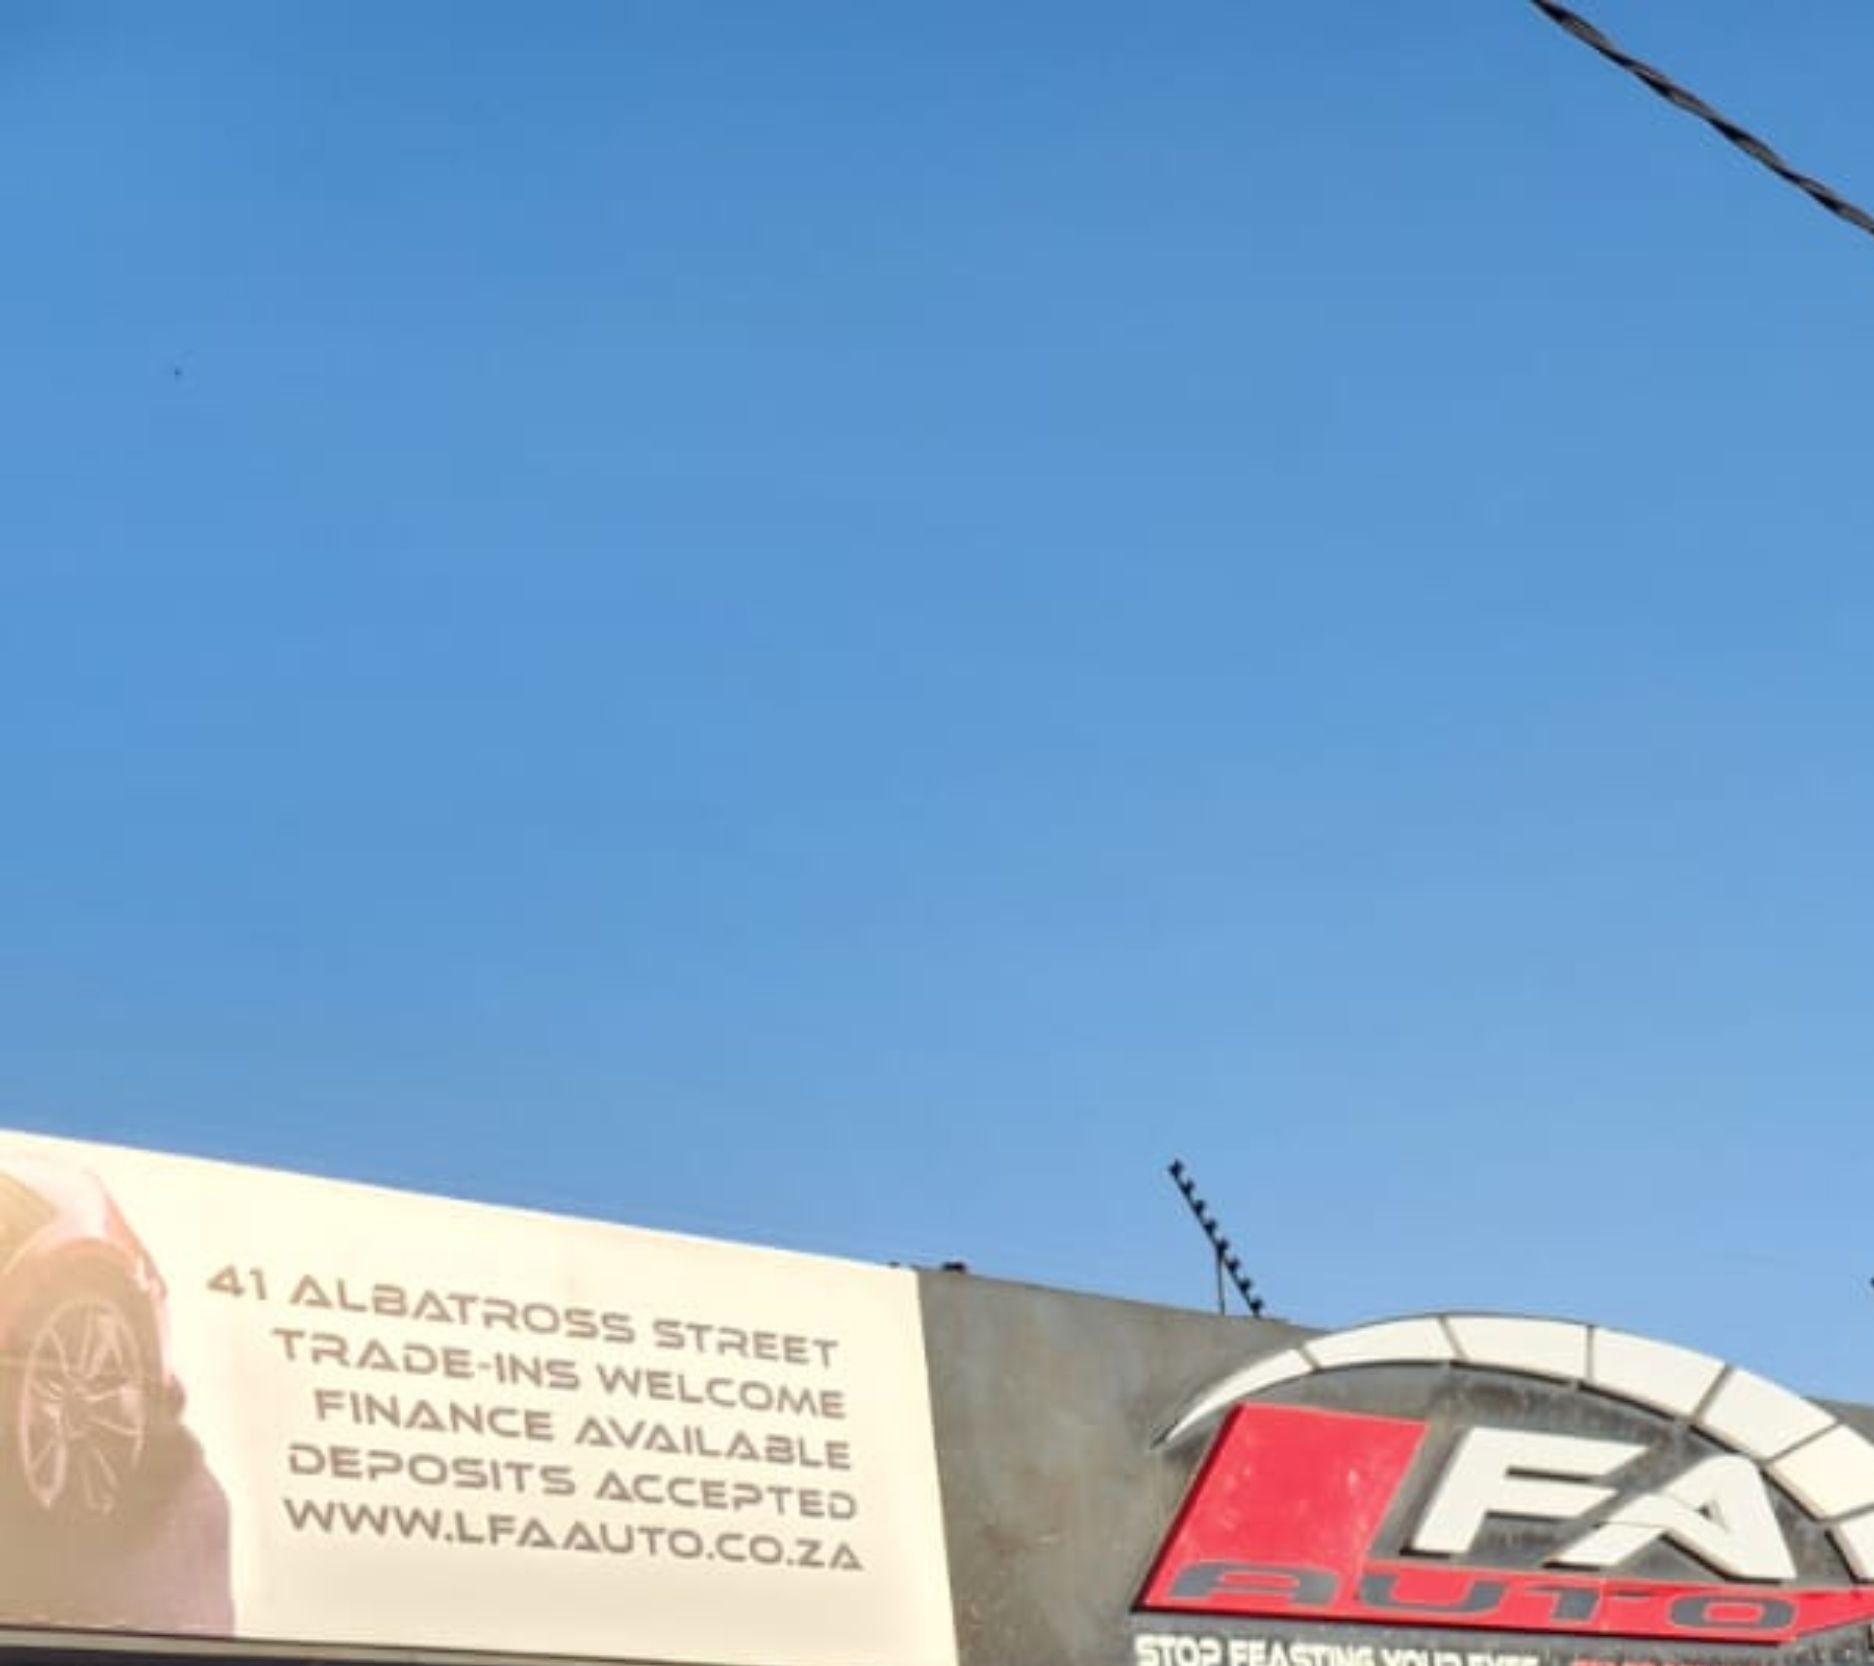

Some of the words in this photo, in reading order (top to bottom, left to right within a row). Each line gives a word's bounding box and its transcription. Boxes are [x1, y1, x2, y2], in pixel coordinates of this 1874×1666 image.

[207, 1264, 267, 1301] 41
[289, 1274, 636, 1344] ALBATROSS
[651, 1318, 839, 1369] STREET
[270, 1327, 581, 1391] TRADE-INS
[595, 1362, 847, 1420] WELCOME
[314, 1388, 556, 1442] FINANCE
[575, 1415, 851, 1471] AVAILABLE
[288, 1442, 577, 1497] DEPOSITS
[594, 1470, 858, 1520] ACCEPTED
[282, 1496, 864, 1571] WWW.LFAAUTO.CO.ZA
[1167, 1562, 1798, 1630] AUTO
